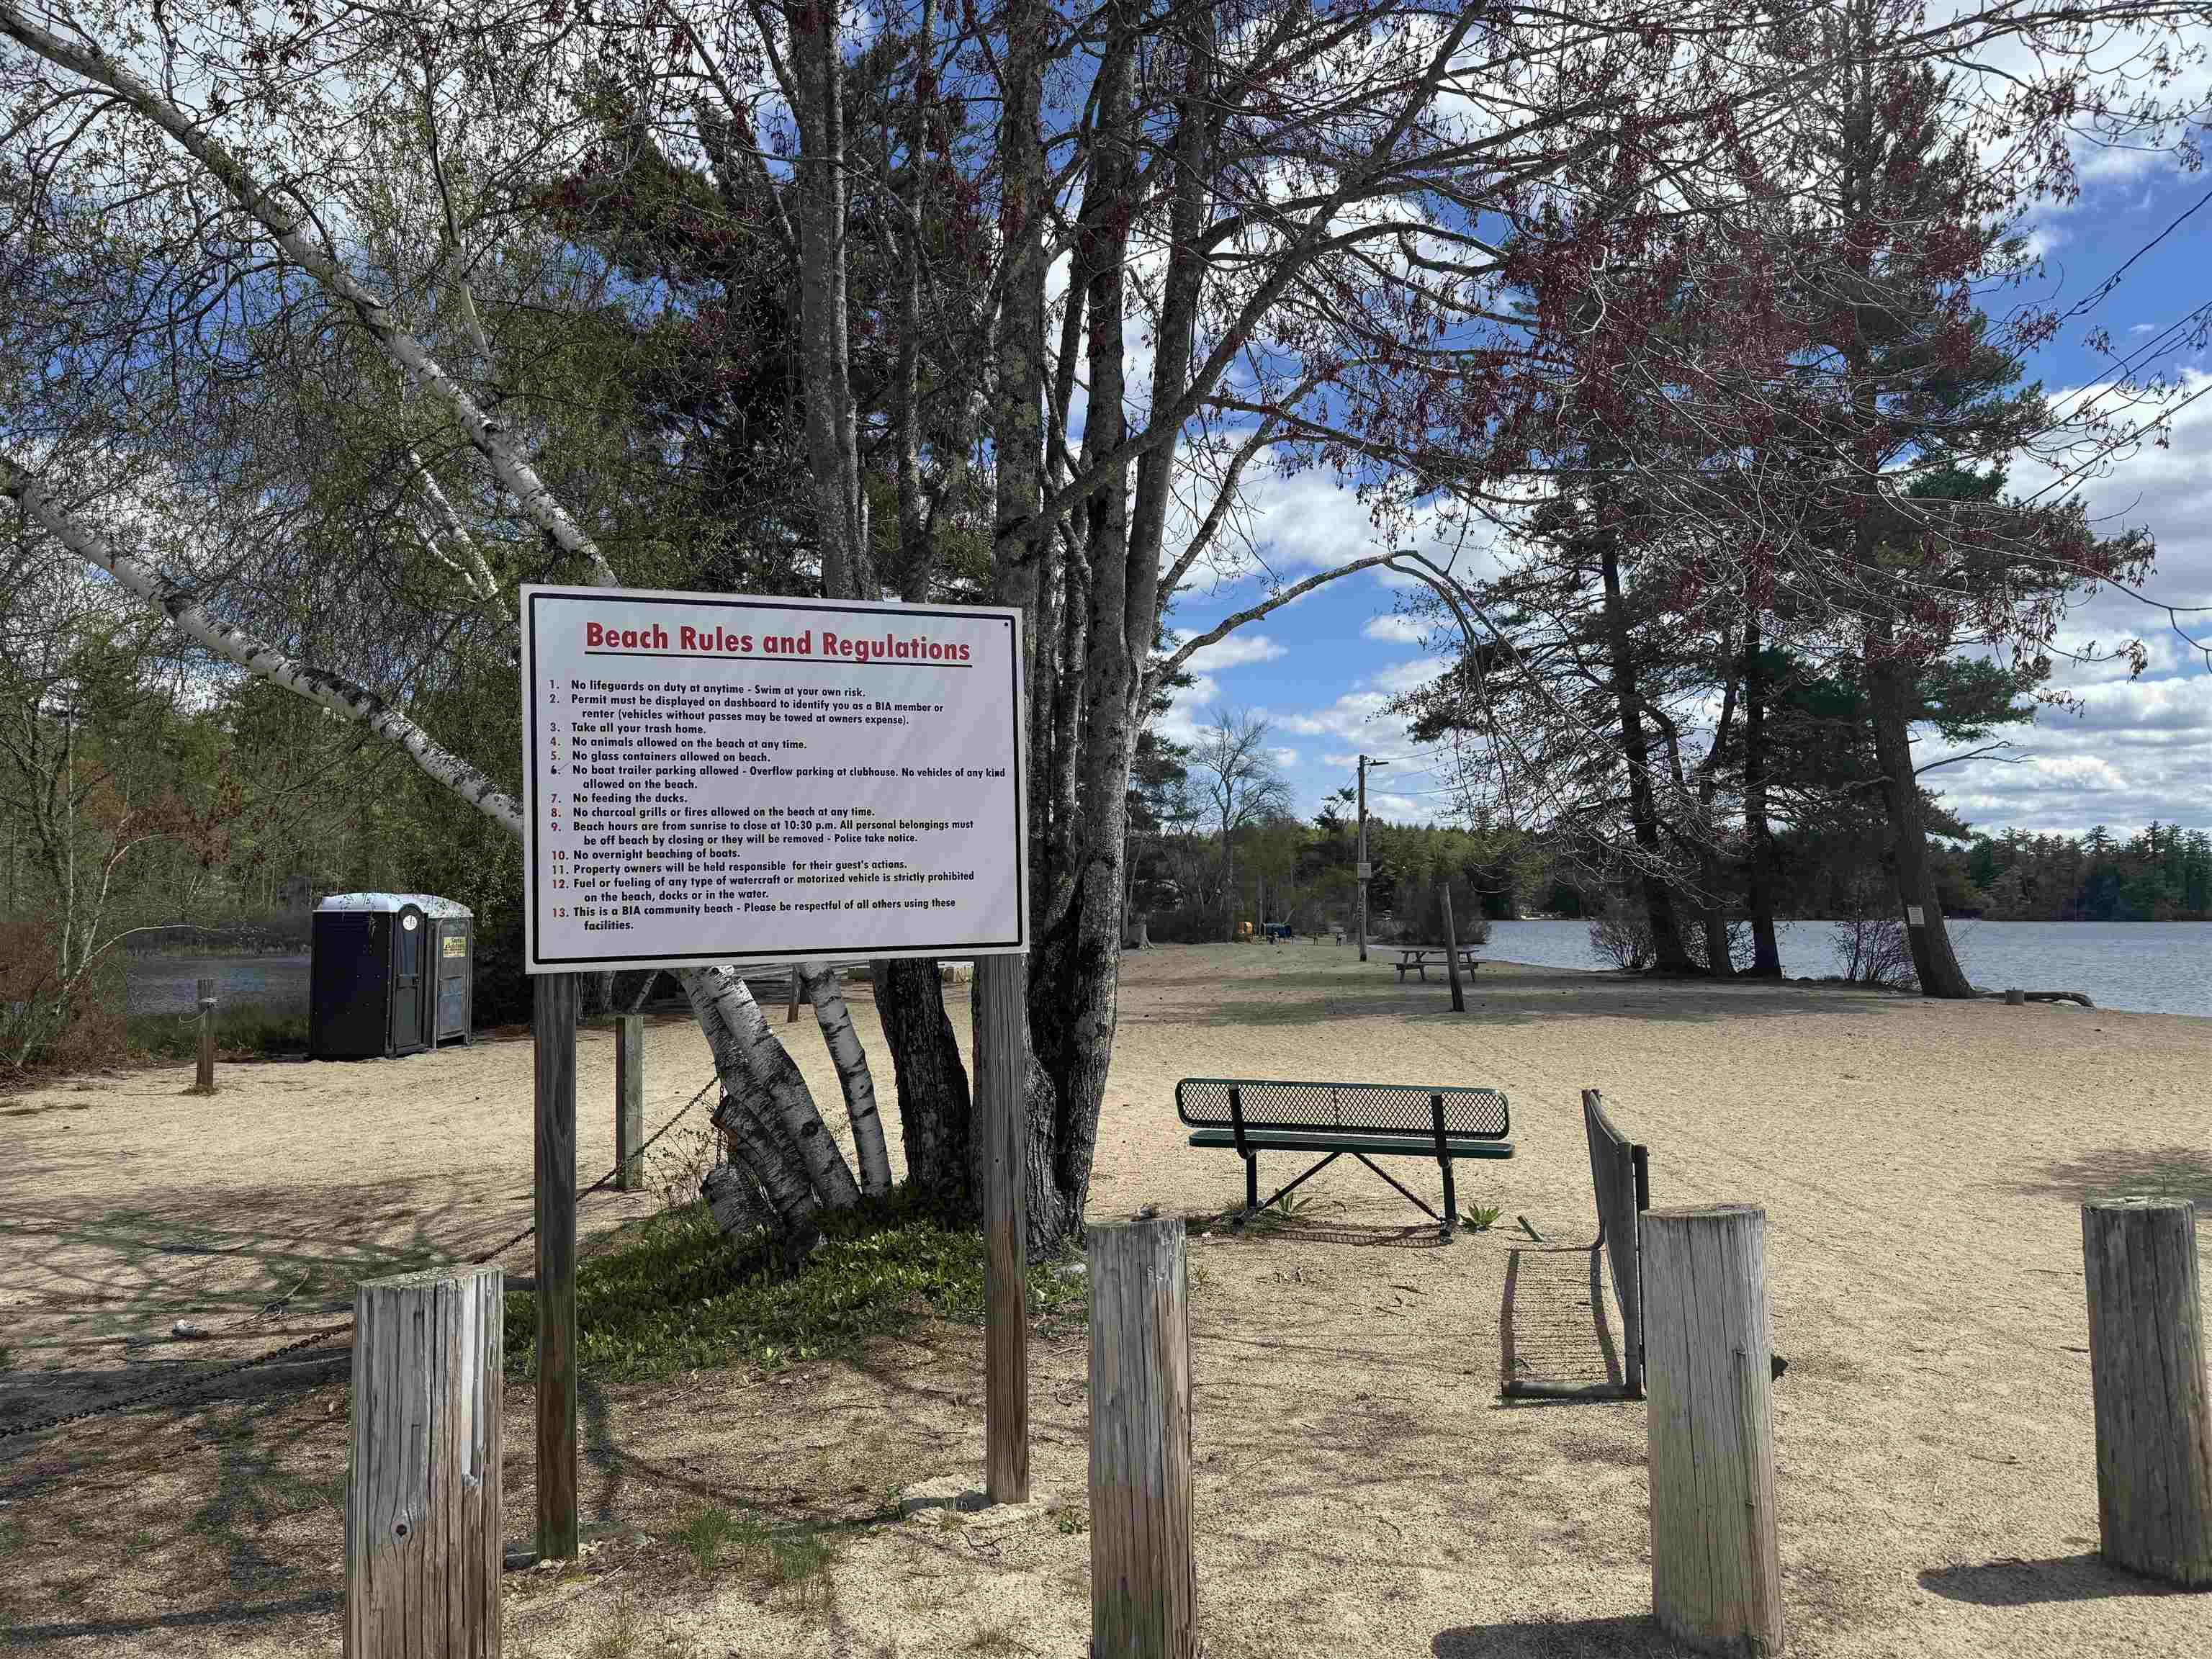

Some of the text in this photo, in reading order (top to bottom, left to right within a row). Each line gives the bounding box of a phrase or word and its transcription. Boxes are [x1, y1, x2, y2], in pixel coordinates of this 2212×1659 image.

[587, 622, 968, 662] Beach Rules and Regulations
[549, 679, 559, 689] 1.
[571, 679, 586, 689] No
[590, 680, 644, 692] lifeguards
[663, 681, 687, 693] duty
[703, 683, 745, 695] anytime
[755, 684, 781, 694] Swim
[796, 685, 819, 697] your
[844, 687, 866, 696] risk.
[549, 693, 559, 703] 2.
[571, 693, 607, 703] Permit
[639, 694, 652, 705] be
[655, 696, 705, 707] displayed
[724, 697, 777, 708] dashboard
[780, 699, 790, 708] to
[793, 698, 830, 711] identify
[832, 702, 850, 711] you
[875, 701, 892, 711] BIA
[894, 702, 932, 711] member
[549, 721, 706, 734] 3. Take all your trash home.
[550, 737, 561, 746] 4.
[572, 736, 588, 746] No
[590, 737, 634, 746] animals
[637, 737, 678, 747] allowed
[696, 737, 713, 747] the
[716, 737, 745, 747] beach
[781, 739, 807, 748] time.
[550, 750, 561, 760] 5.
[572, 750, 588, 760] No
[591, 750, 619, 762] glass
[622, 751, 677, 760] containers
[680, 751, 720, 761] allowed
[739, 752, 770, 761] beach.
[583, 778, 625, 788] allowed
[644, 778, 661, 788] the
[665, 778, 698, 788] beach.
[551, 792, 688, 804] 7. No feeding the ducks.
[551, 807, 562, 817] 8.
[573, 806, 588, 818] No
[591, 806, 636, 817] charcoal
[639, 806, 667, 819] grills
[684, 806, 708, 816] fires
[711, 806, 750, 816] allowed
[753, 807, 765, 816] on
[768, 806, 784, 817] the
[787, 806, 815, 816] beach
[817, 807, 828, 816] at
[830, 809, 848, 818] any
[851, 806, 875, 816] time.
[551, 822, 562, 831] 9.
[573, 821, 605, 830] Beach
[608, 821, 638, 830] hours
[662, 820, 687, 830] from
[690, 821, 727, 830] sunrise
[742, 820, 768, 830] close
[770, 821, 781, 830] at
[784, 820, 812, 830] 10:30
[815, 822, 837, 831] p.m.
[840, 819, 853, 829] All
[856, 819, 896, 831] personal
[899, 819, 949, 830] belongings
[552, 848, 740, 860] 10. No overnight beaching of boats.
[552, 865, 569, 874] 11.
[573, 864, 621, 875] Property
[665, 862, 685, 872] will
[688, 862, 701, 872] be
[703, 861, 725, 871] held
[729, 860, 786, 873] responsible
[792, 860, 807, 870] for
[809, 860, 833, 869] their
[835, 859, 869, 871] guest's
[871, 858, 907, 868] actions.
[552, 878, 569, 889] 12.
[573, 877, 595, 888] Fuel
[613, 877, 651, 888] fueling
[654, 876, 665, 886] of
[668, 878, 688, 888] any
[691, 877, 713, 887] type
[716, 875, 727, 885] of
[729, 874, 781, 884] watercraft
[797, 873, 845, 883] motorized
[848, 872, 880, 882] vehicle
[882, 873, 891, 881] is
[893, 872, 925, 883] strictly
[927, 871, 974, 883] prohibited
[601, 891, 618, 902] the
[621, 890, 655, 902] beach,
[659, 890, 688, 900] docks
[706, 889, 716, 899] in
[719, 889, 735, 899] the
[552, 907, 570, 917] 13.
[573, 906, 595, 916] This
[598, 906, 608, 916] is
[621, 905, 641, 914] BIA
[644, 904, 701, 915] community
[703, 902, 733, 913] beach
[744, 902, 777, 912] Please
[779, 901, 791, 911] be
[794, 900, 841, 912] respectful
[844, 899, 854, 909] of
[856, 899, 869, 909] all
[871, 899, 902, 908] others
[904, 898, 929, 909] using
[932, 897, 956, 907] these
[584, 920, 634, 930] facilities.
